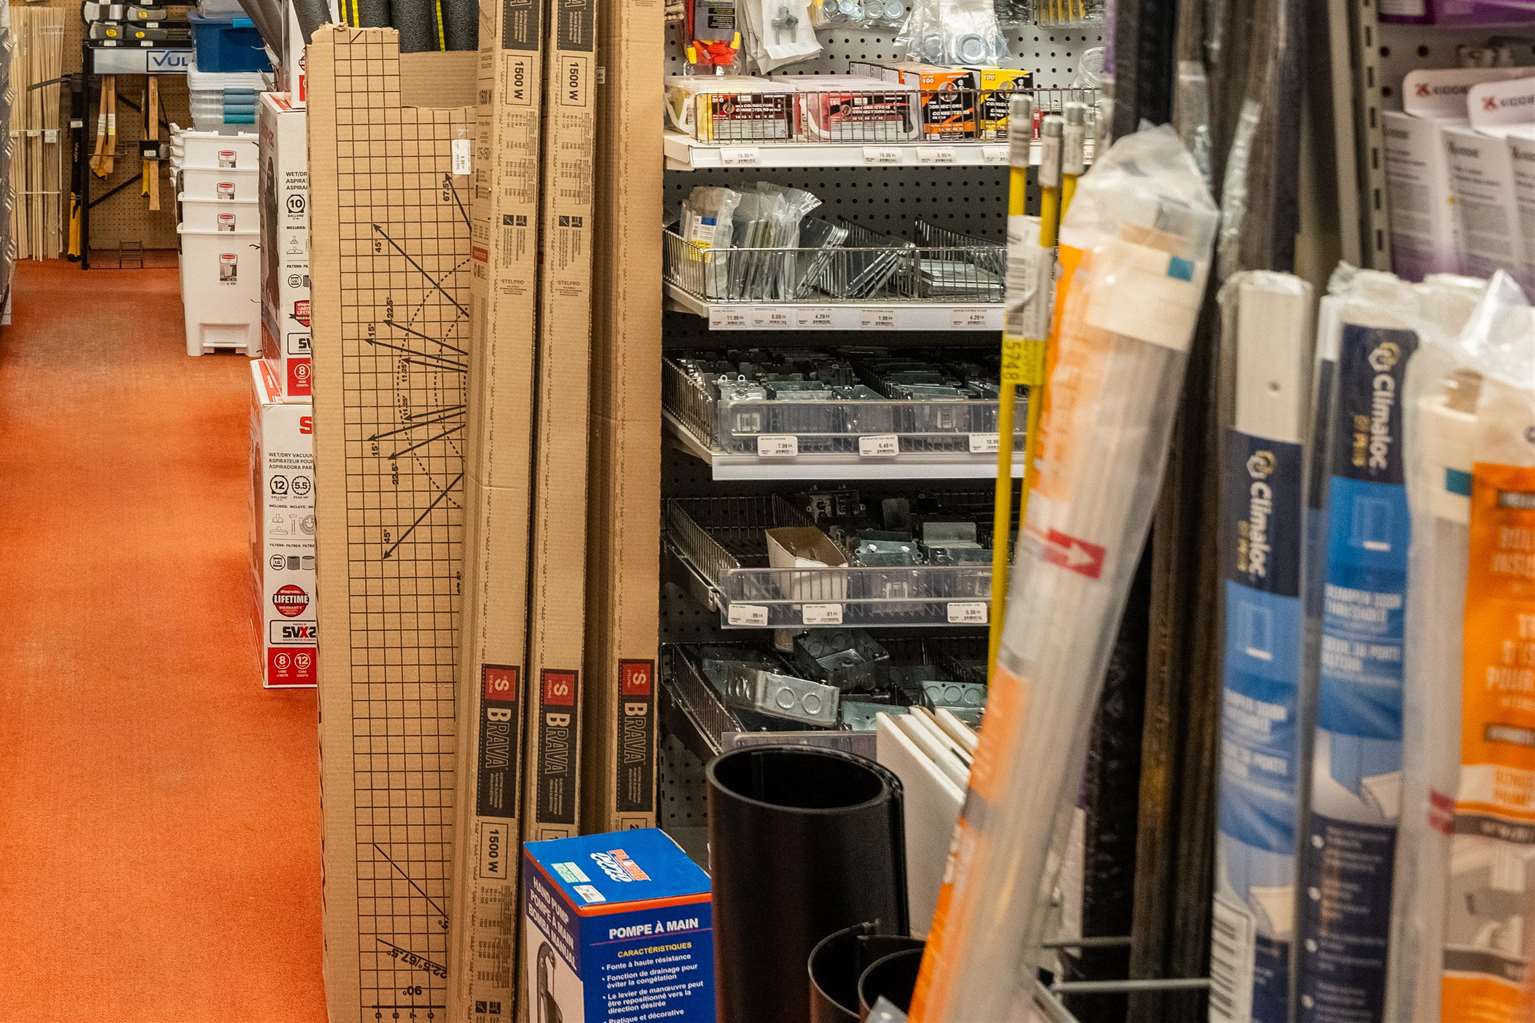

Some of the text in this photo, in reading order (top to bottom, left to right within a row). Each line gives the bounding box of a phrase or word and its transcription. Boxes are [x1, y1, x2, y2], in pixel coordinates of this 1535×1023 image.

[514, 61, 525, 100] 1500 W
[569, 61, 579, 101] 1500 W
[289, 199, 303, 208] 10
[1368, 375, 1396, 471] Climaloc
[274, 480, 308, 490] 12 5.5
[1249, 480, 1273, 579] Climaloc
[274, 595, 310, 604] LIFETIME
[282, 626, 316, 638] SVX2
[297, 656, 309, 665] 12
[485, 707, 512, 769] BRAVA
[624, 702, 648, 764] BRAVA
[544, 712, 571, 775] BRAVA
[488, 829, 499, 873] 1500 W
[530, 888, 552, 920] POMPE
[532, 875, 569, 924] HAND PUMP
[608, 917, 699, 940] POMPE À MAIN
[617, 941, 693, 958] CARACTÉRISTIQUES
[606, 962, 627, 971] Fonte
[634, 958, 654, 967] haute
[655, 953, 691, 964] résistance
[607, 972, 638, 982] Fonction
[649, 966, 680, 976] drainage
[681, 963, 699, 973] pour
[607, 980, 627, 989] éviter
[636, 973, 677, 985] congélation
[607, 999, 622, 1007] être
[623, 992, 667, 1005] repositionné
[667, 991, 684, 999] vers
[618, 989, 638, 999] levier
[649, 983, 687, 994] manœuvre
[688, 980, 704, 989] peut
[608, 1000, 667, 1015] direction désirée
[608, 1015, 639, 1023] Pratique
[648, 1008, 685, 1020] décorative
